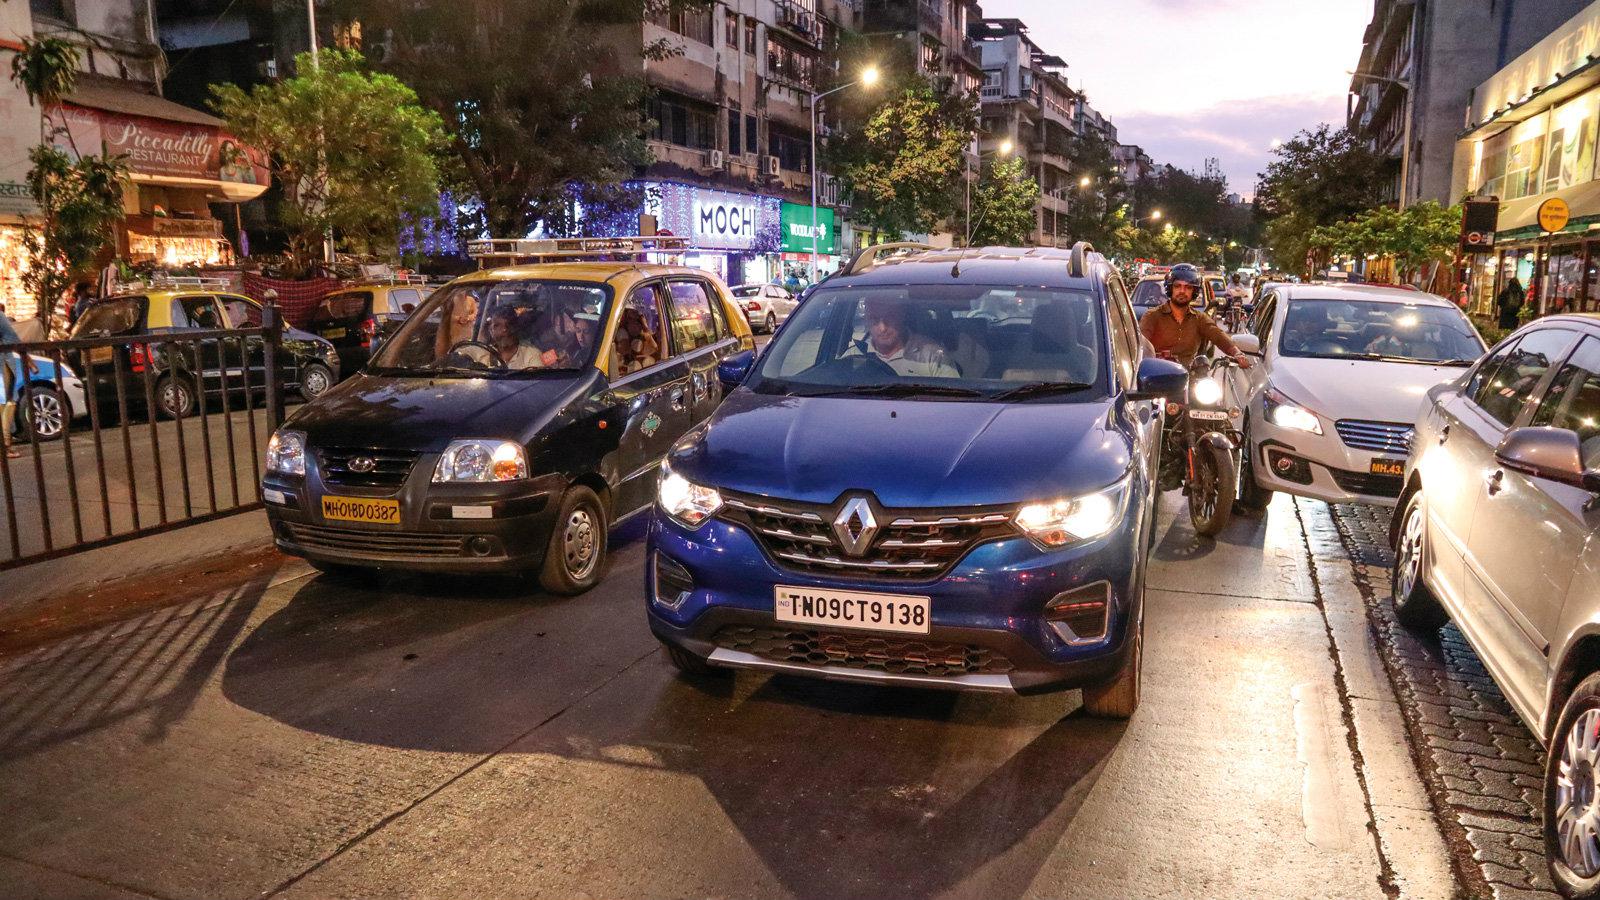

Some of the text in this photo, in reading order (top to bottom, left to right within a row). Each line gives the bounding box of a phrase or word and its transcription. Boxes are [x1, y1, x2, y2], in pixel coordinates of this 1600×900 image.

[107, 121, 213, 163] Piccadilly
[126, 148, 200, 166] RESTAURANT
[700, 204, 756, 239] MOCHI
[790, 223, 820, 239] WOODLAD
[789, 594, 925, 626] TN09CT9138
